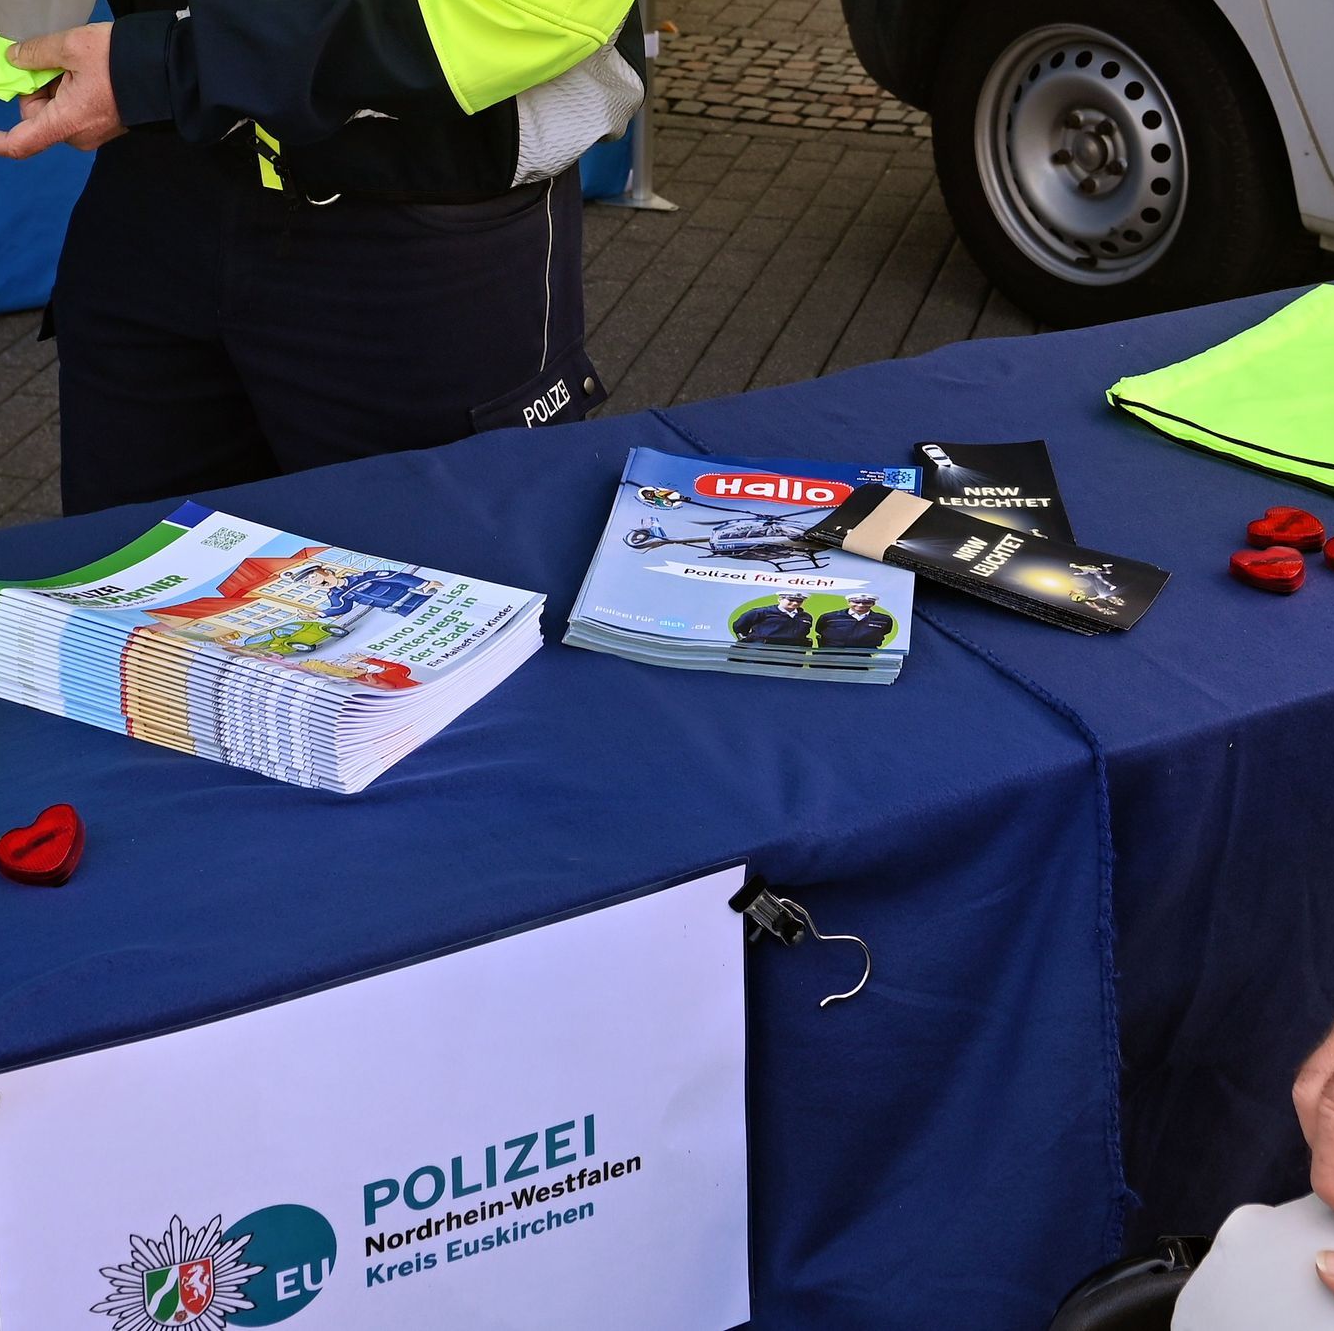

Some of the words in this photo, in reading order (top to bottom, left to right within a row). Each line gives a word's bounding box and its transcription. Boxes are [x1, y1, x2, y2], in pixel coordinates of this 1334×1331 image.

[715, 476, 836, 503] Hallo
[938, 496, 1052, 509] LEUCHTET
[963, 486, 1020, 497] NRW
[952, 535, 988, 563] NRW
[969, 532, 1025, 578] LEUCHTET
[104, 574, 189, 605] PARTNER
[754, 573, 782, 587] für
[787, 576, 834, 589] dich!
[367, 625, 415, 652] Bruno
[412, 604, 443, 626] und
[436, 582, 470, 605] Lisa
[389, 608, 464, 658] unterwegs
[456, 596, 478, 609] in
[426, 657, 442, 668] Ein
[441, 635, 474, 663] Malheft
[471, 627, 489, 639] für
[484, 603, 514, 628] Kinder
[409, 645, 435, 663] der
[431, 620, 475, 649] Stadt
[362, 1112, 597, 1228] POLIZEI
[364, 1154, 643, 1258] Nordrhein-Westfalen
[364, 1251, 438, 1289] Kreis
[445, 1201, 596, 1267] Euskirchen
[275, 1258, 332, 1301] EU
